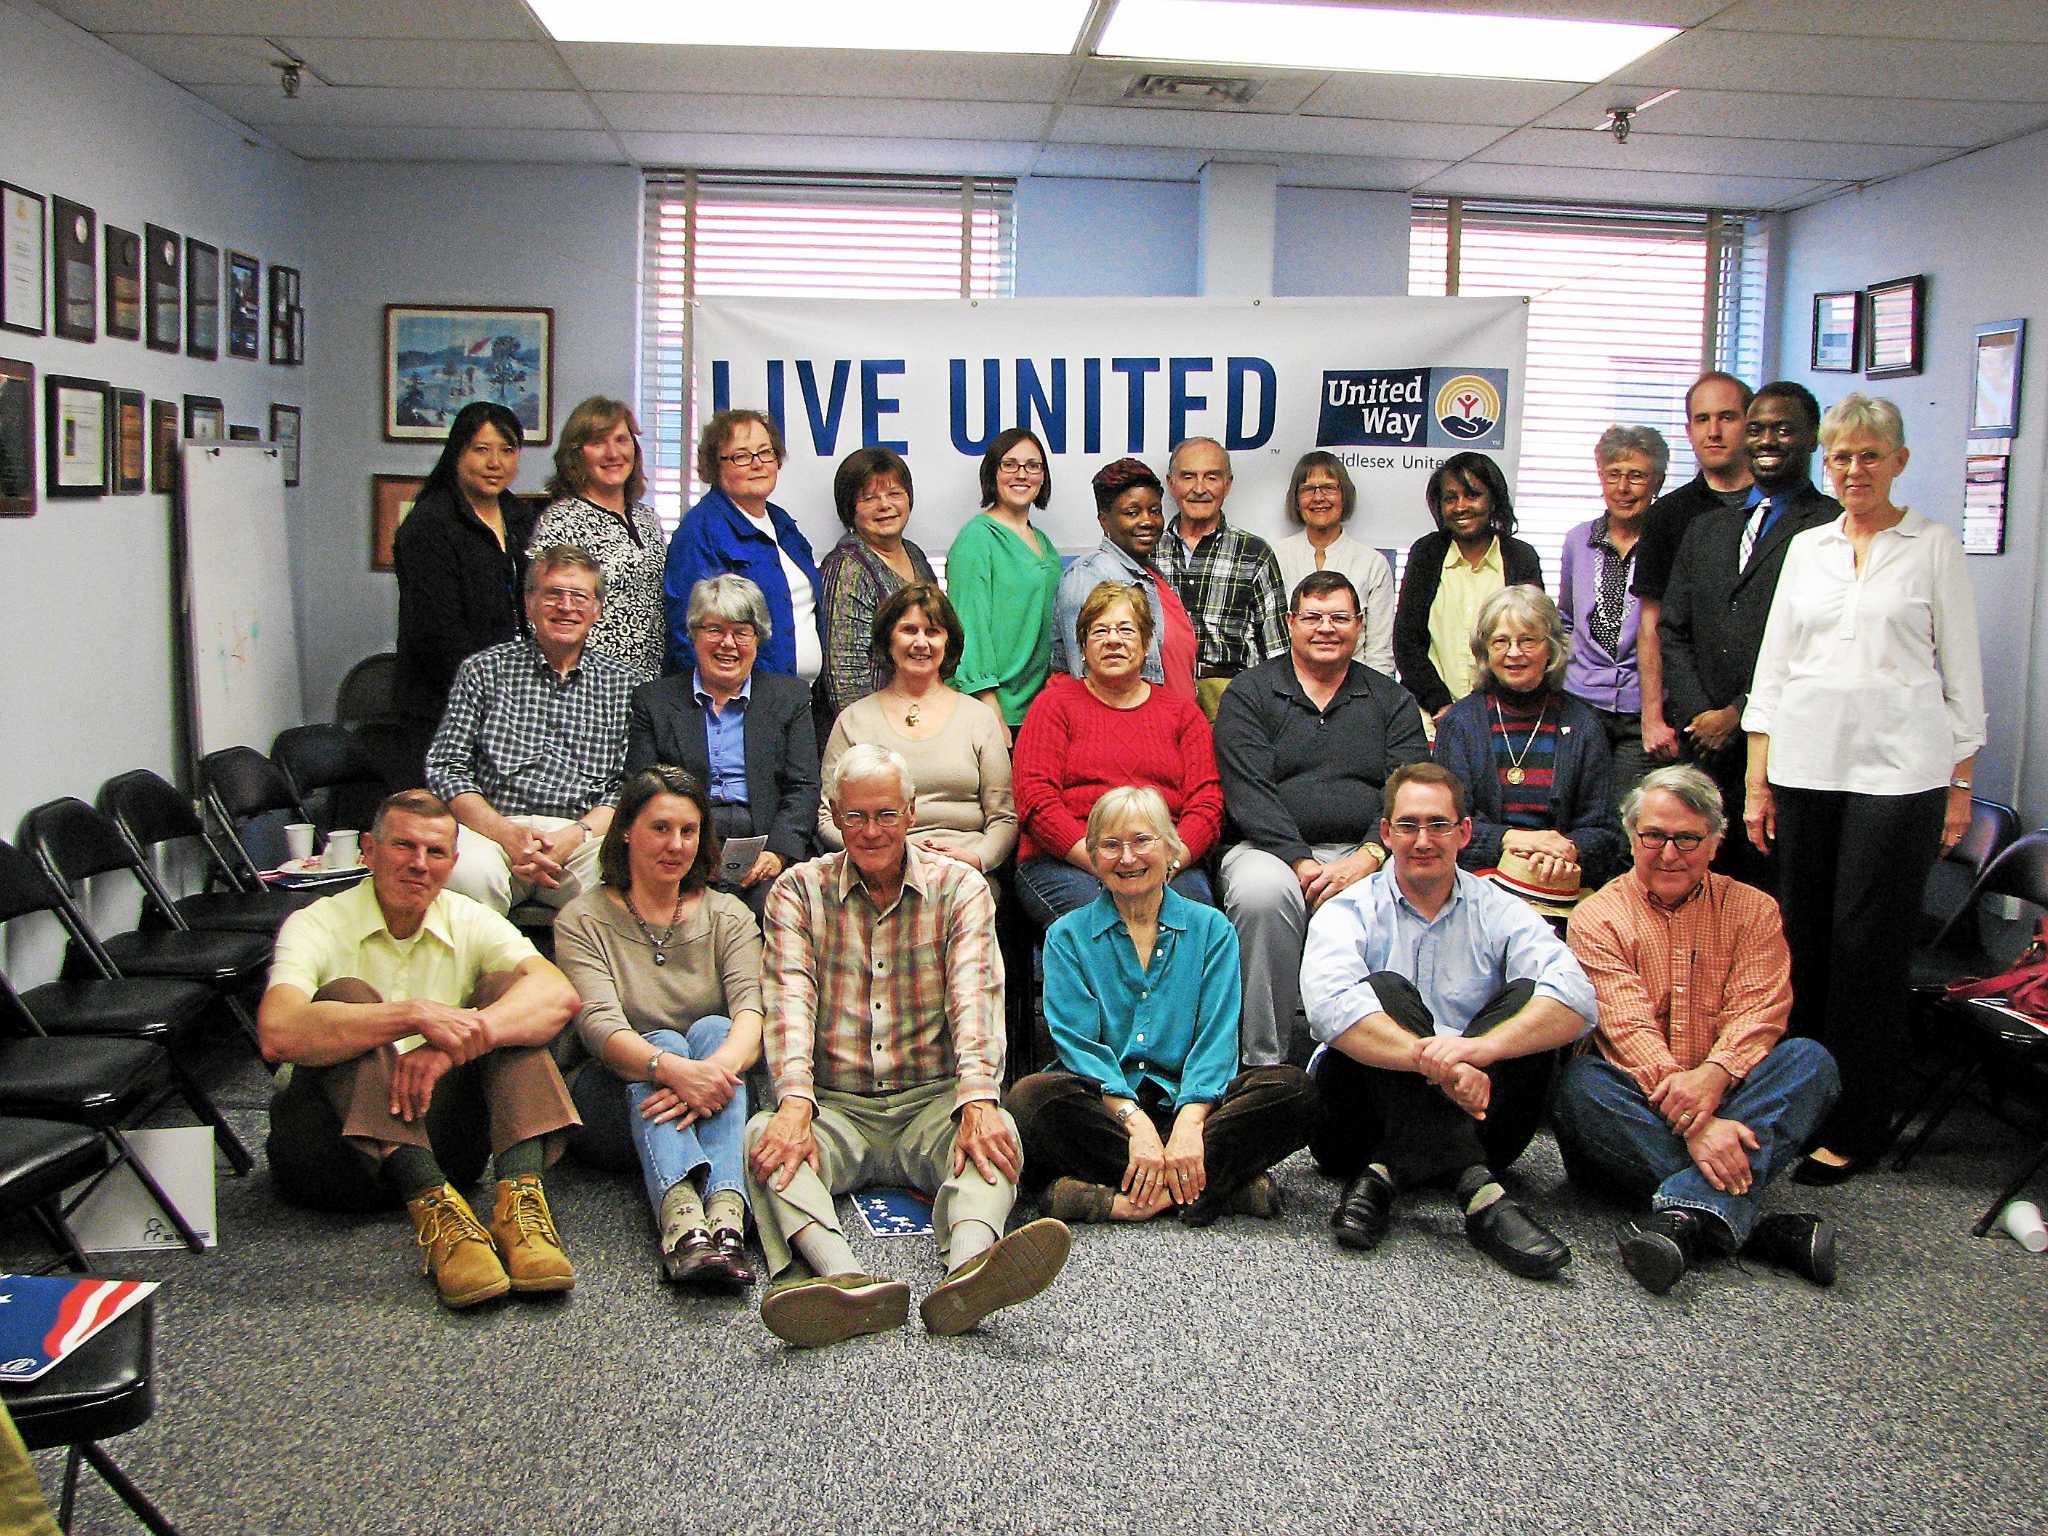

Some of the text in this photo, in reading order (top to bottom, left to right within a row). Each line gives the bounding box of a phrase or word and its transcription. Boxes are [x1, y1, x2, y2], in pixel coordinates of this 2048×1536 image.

[950, 357, 1276, 456] UNITED
[1328, 376, 1422, 407] United
[1362, 407, 1421, 443] Way
[1338, 453, 1446, 469] ddlesex Unite
